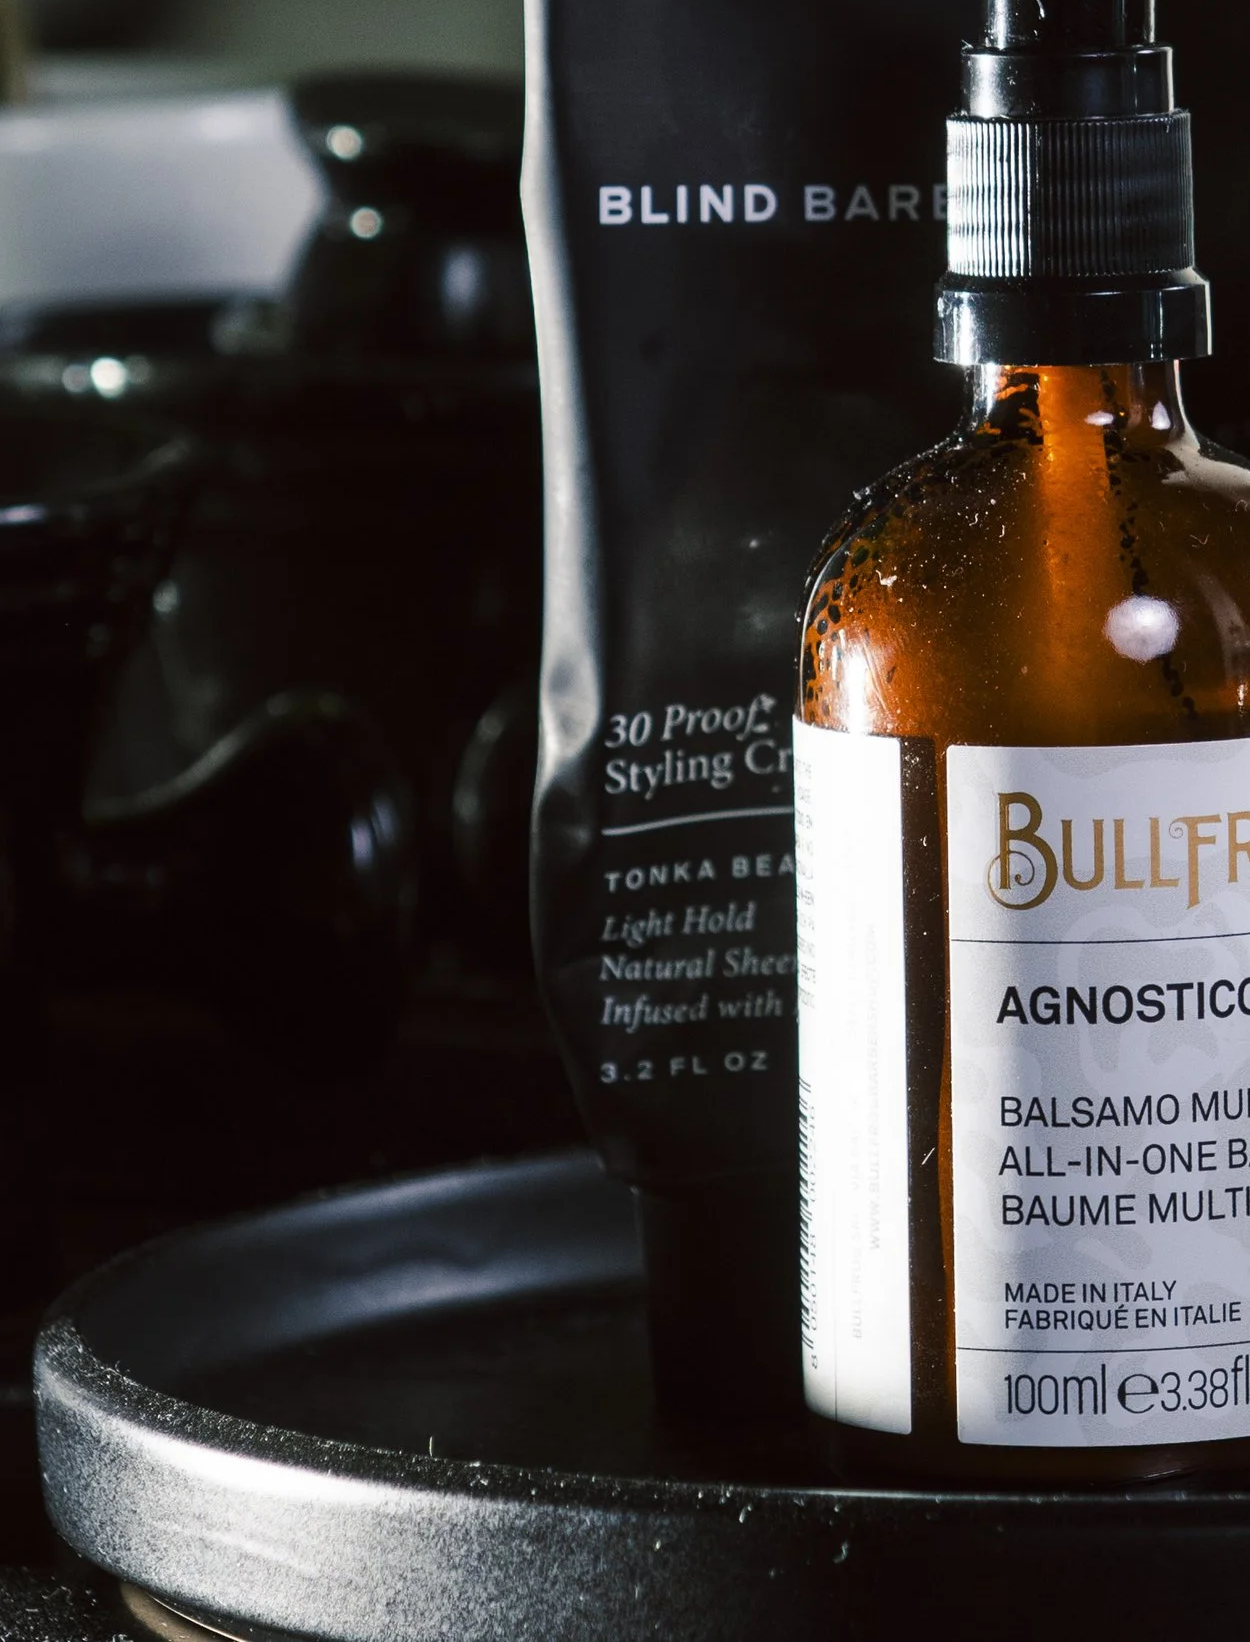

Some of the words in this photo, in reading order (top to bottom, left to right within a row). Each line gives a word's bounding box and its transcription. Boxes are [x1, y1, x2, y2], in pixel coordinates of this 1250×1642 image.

[599, 184, 778, 225] BLIND
[604, 710, 652, 749] 30
[604, 749, 733, 800] Styling
[604, 860, 716, 893] TONKA
[601, 909, 674, 948] Light
[682, 901, 757, 935] Hold
[600, 948, 715, 981] Natural
[601, 993, 709, 1034] Infused
[719, 990, 783, 1018] with
[600, 1060, 654, 1084] 3.2
[669, 1056, 708, 1076] FL
[724, 1051, 769, 1072] OZ
[1000, 1093, 1181, 1129] BALSAMO
[998, 1141, 1218, 1176] ALL-IN-ONE
[1002, 1195, 1136, 1226] BAUME
[1004, 1283, 1075, 1303] MADE
[1081, 1283, 1104, 1302] IN
[1113, 1280, 1177, 1301] ITALY
[1004, 1304, 1129, 1331] FABRIQUÉ
[1135, 1310, 1167, 1329] EN
[1173, 1302, 1242, 1327] ITALIE
[1004, 1364, 1107, 1415] 100ml
